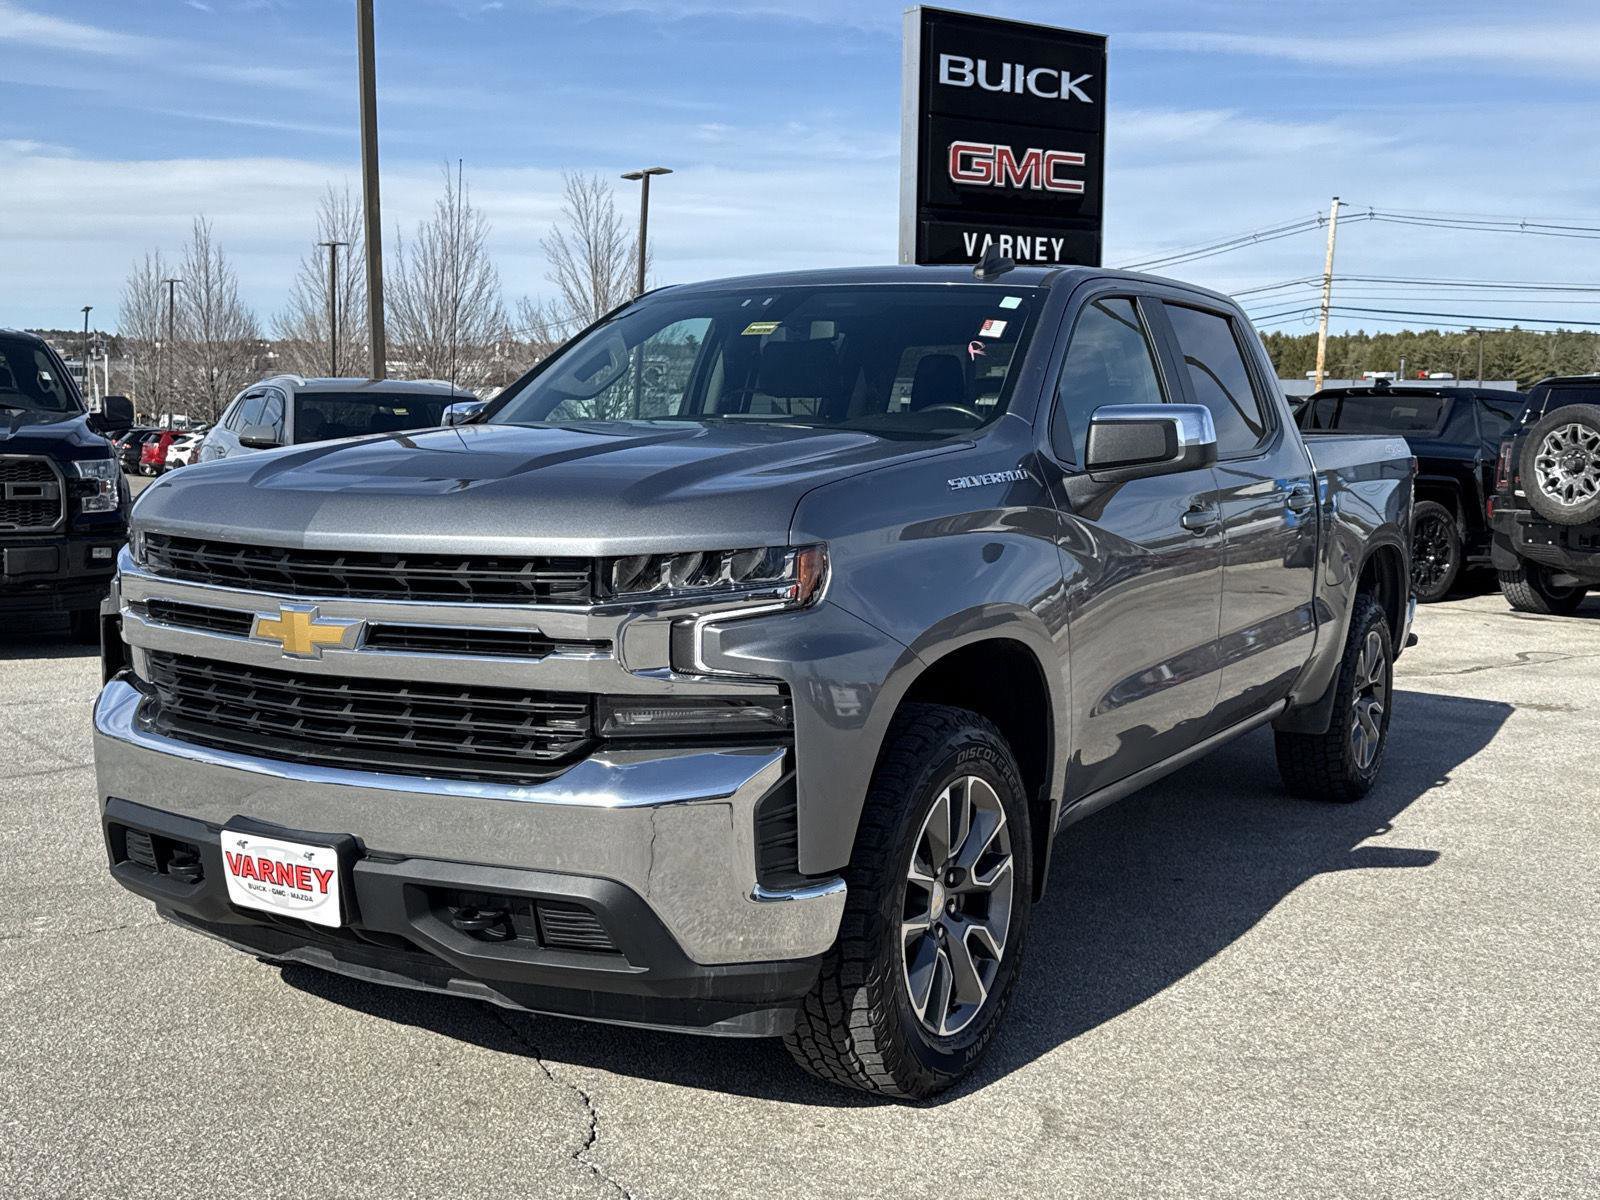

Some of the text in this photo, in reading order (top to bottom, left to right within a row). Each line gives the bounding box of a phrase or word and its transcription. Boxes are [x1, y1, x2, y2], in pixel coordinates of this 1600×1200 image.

[939, 53, 1094, 103] BUICK
[949, 140, 1086, 194] GMC
[963, 232, 1065, 262] VARNEY
[947, 469, 1029, 491] SILVERADO
[225, 851, 335, 894] VARNEY
[247, 882, 314, 903] BUICK GMC MAZDA
